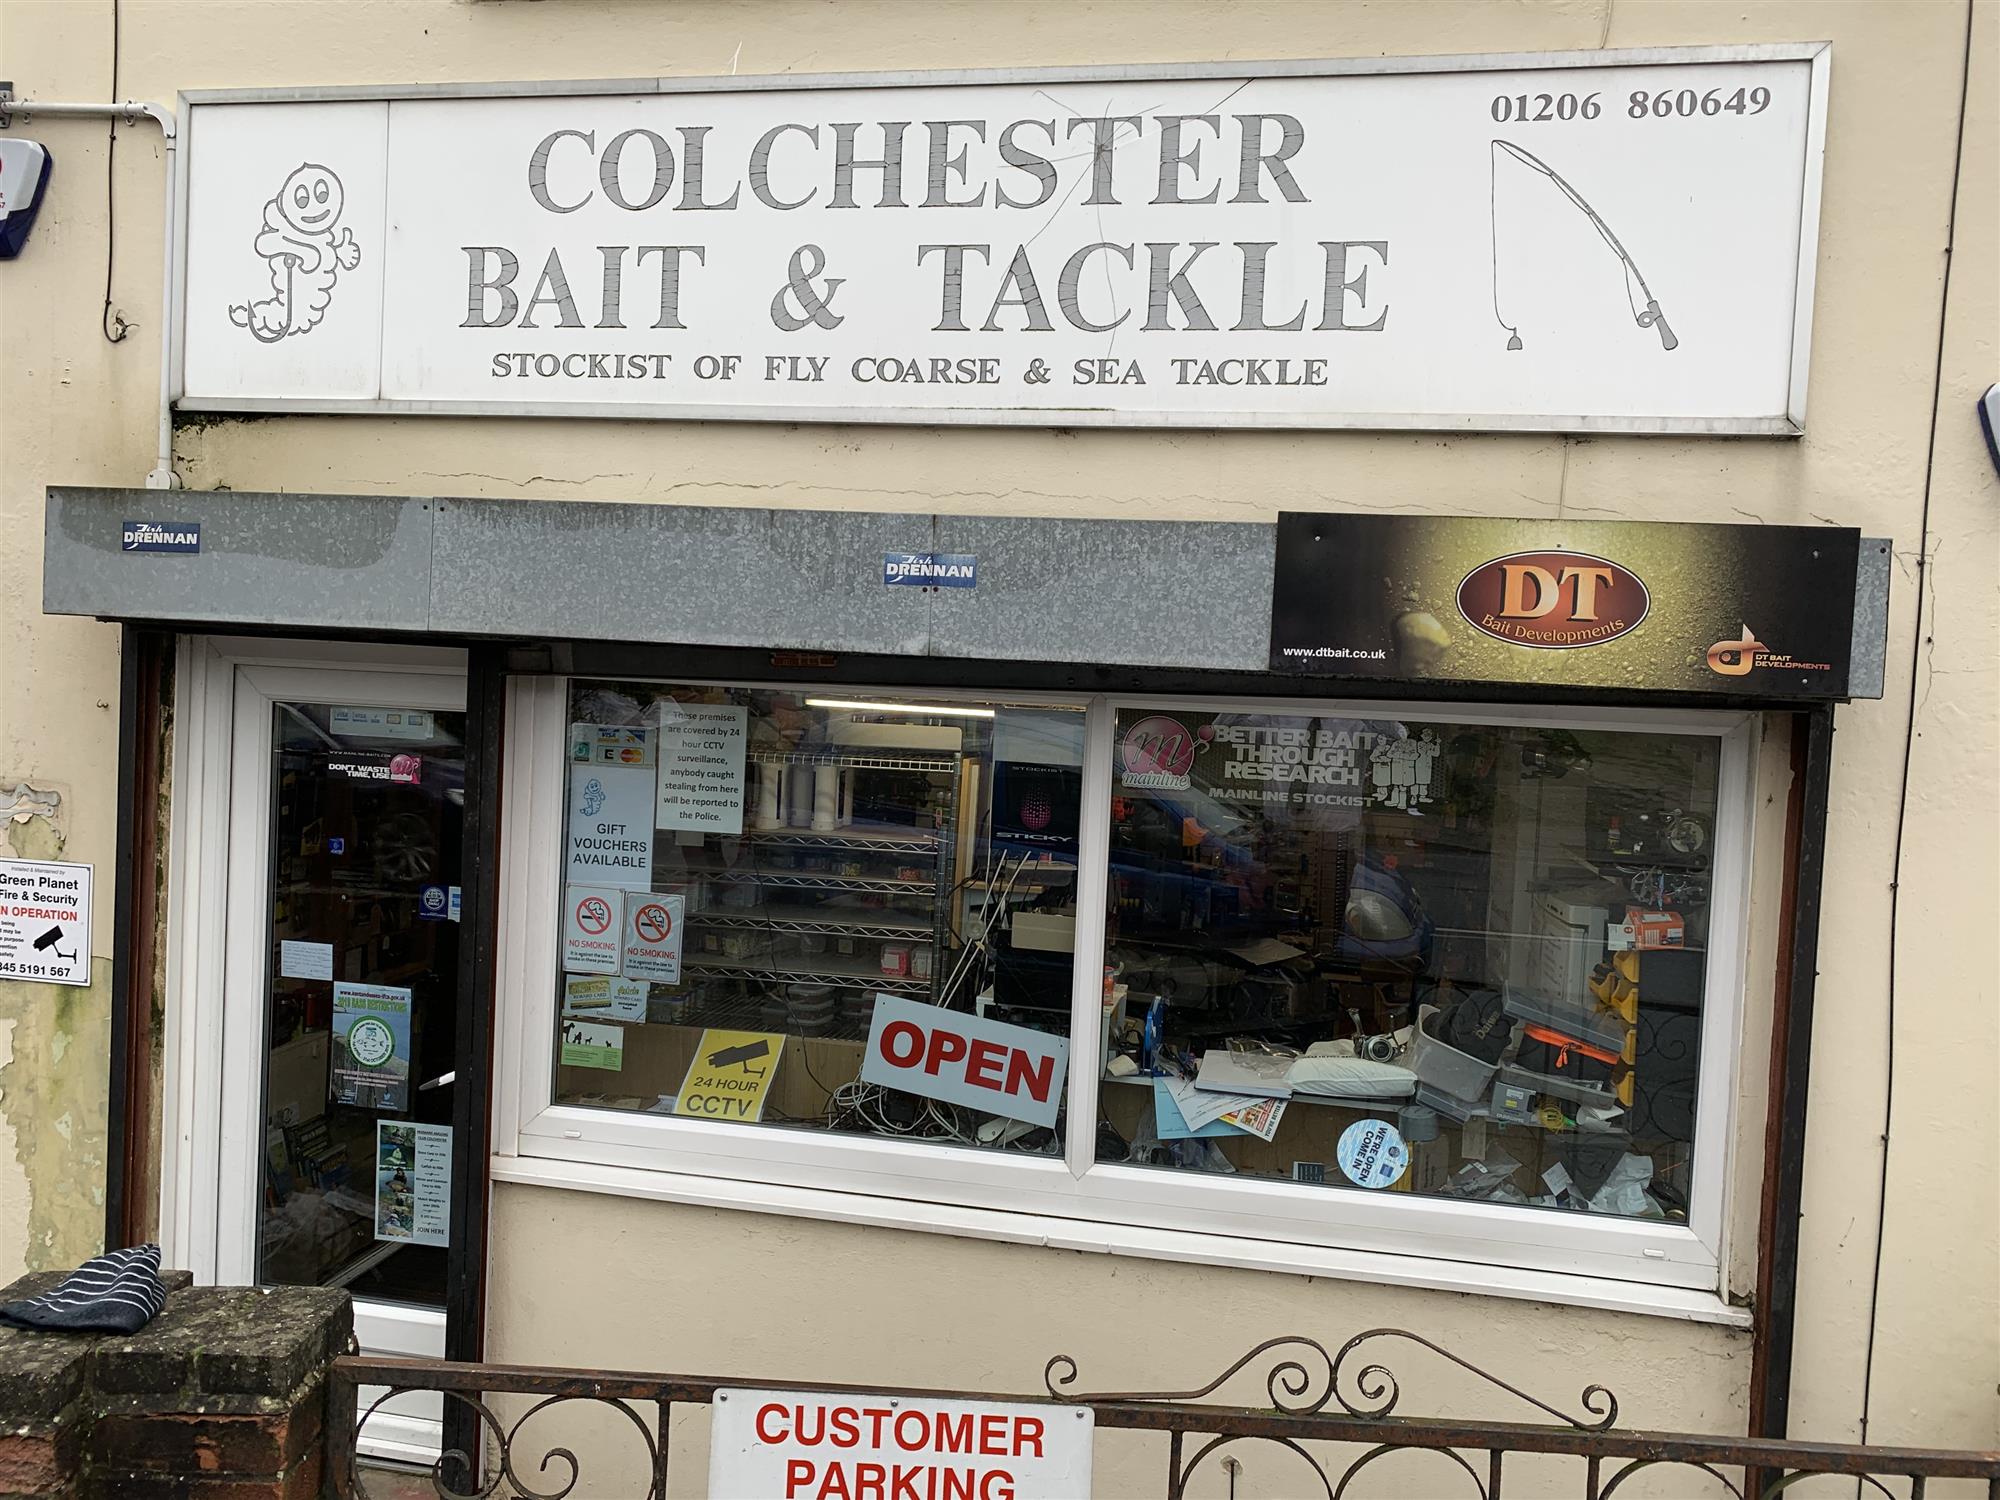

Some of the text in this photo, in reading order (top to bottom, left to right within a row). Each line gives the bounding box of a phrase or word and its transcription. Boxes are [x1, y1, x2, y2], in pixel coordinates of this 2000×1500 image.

[1491, 87, 1771, 122] 01206 860649
[528, 114, 1311, 213] COLCHESTER
[459, 241, 1388, 332] BAIT & TACKLE
[492, 353, 1328, 386] STOCKIST OF FLY COARSE & SEA TACKLE
[124, 532, 197, 545] DRENNAN
[886, 563, 974, 578] DRENNAN
[1499, 565, 1613, 622] DT
[1481, 614, 1625, 643] Bait Developments
[1283, 647, 1386, 659] www.dtbait.co.uk
[1755, 654, 1792, 663] DT BAIT
[1755, 661, 1831, 671] DEVELOPMENTS
[673, 711, 736, 722] These premises
[683, 726, 716, 735] covered
[718, 728, 728, 737] by
[729, 728, 740, 736] 24
[1214, 725, 1378, 750] BETTER BAIT
[682, 739, 725, 750] hour CCTV
[677, 755, 728, 765] surveillance,
[1232, 743, 1355, 767] THROUGH
[328, 763, 391, 774] DON'T WASTE
[346, 770, 391, 780] TIME, USE
[670, 768, 735, 780] anybody caught
[1011, 766, 1065, 774] STOCKIST
[1224, 760, 1360, 785] RESEARCH
[1124, 771, 1188, 788] mainline
[665, 782, 739, 794] stealing from here
[663, 796, 739, 808] will be reported to
[1209, 787, 1375, 807] MAINLINE STOCKIST
[679, 810, 722, 821] the Police.
[597, 823, 626, 835] GIFT
[574, 837, 647, 852] VOUCHERS
[995, 832, 1073, 842] STICKY
[573, 853, 646, 868] AVAILABLE
[0, 873, 78, 890] Green Planet
[22, 891, 29, 901] &
[33, 892, 78, 907] Security
[0, 905, 77, 921] N OPERATION
[569, 939, 616, 951] NO SMOKING.
[627, 947, 677, 960] NO SMOKING.
[19, 964, 45, 975] 5191
[50, 966, 70, 977] 567
[880, 1020, 1055, 1103] OPEN
[694, 1076, 759, 1092] 24 HOUR
[686, 1094, 752, 1117] CCTV
[1352, 1130, 1374, 1170] COME IN
[1358, 1127, 1388, 1182] WE'RE OPEN
[756, 1403, 1044, 1457] CUSTOMER
[786, 1459, 1015, 1500] PARKING
